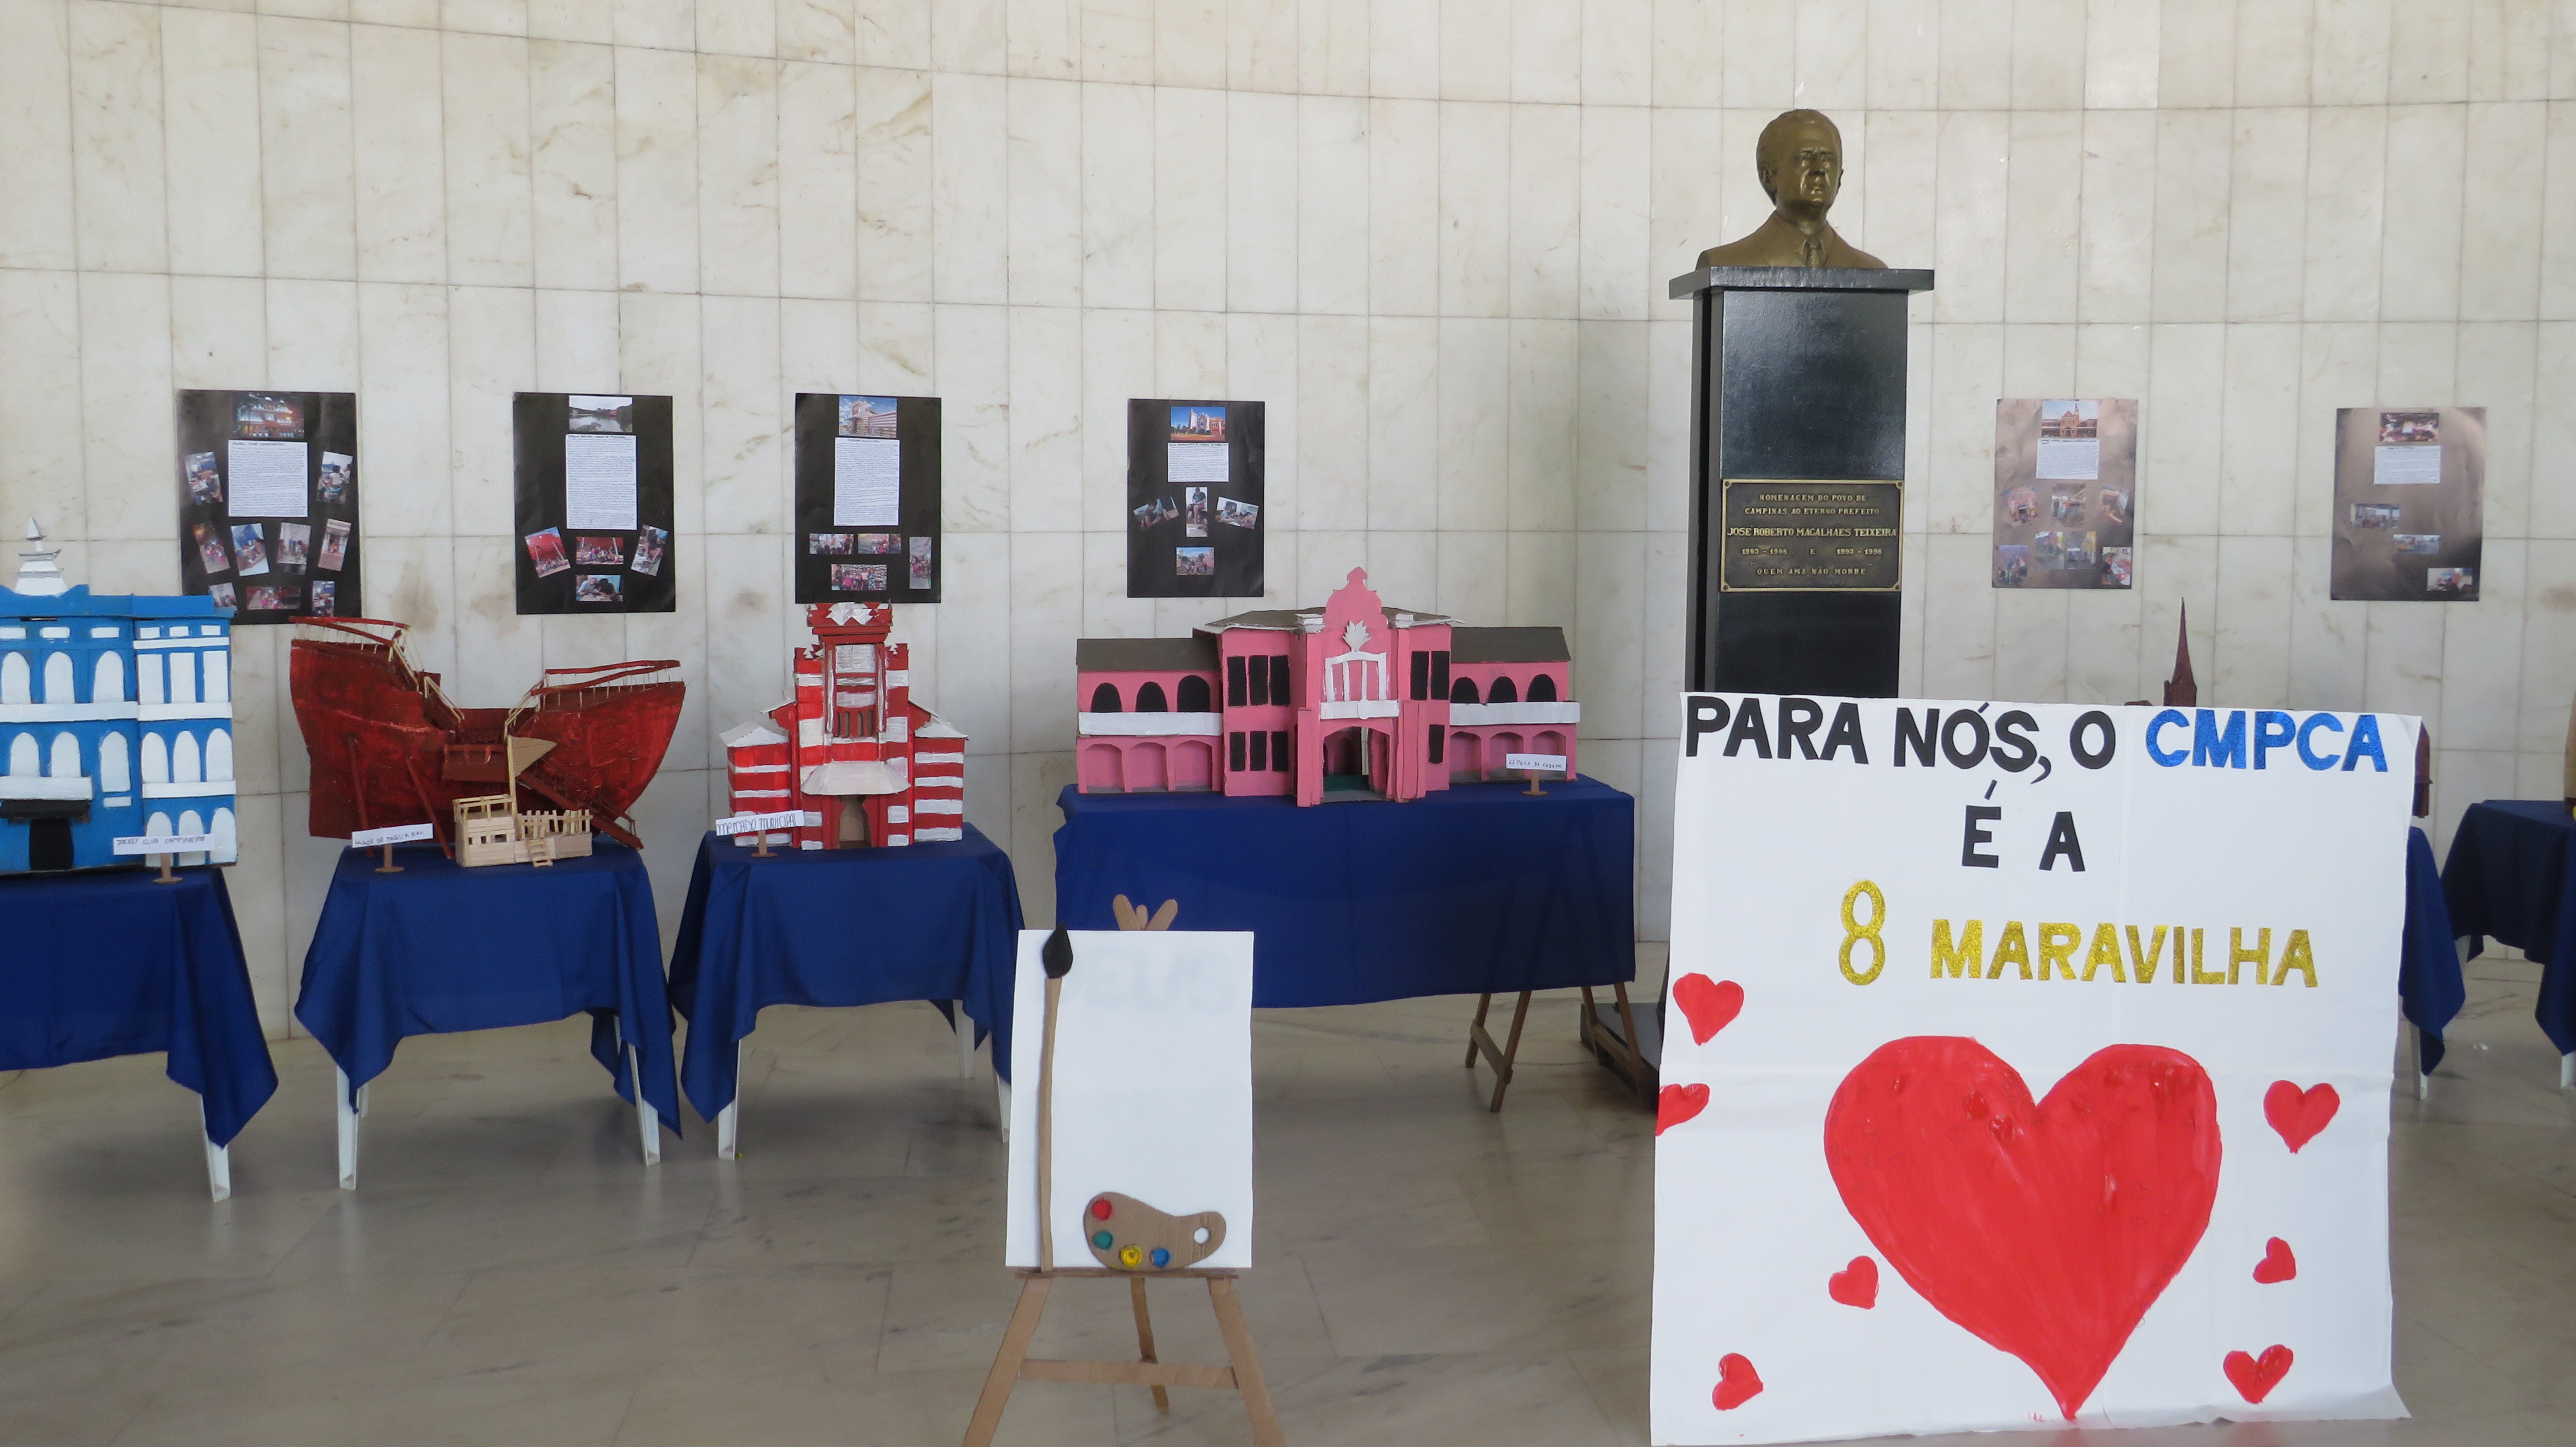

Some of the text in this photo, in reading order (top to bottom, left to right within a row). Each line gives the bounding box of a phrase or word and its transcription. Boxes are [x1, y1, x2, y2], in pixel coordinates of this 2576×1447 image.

[1753, 528, 1794, 537] ROBERTO
[1853, 528, 1897, 537] TEIXEIRA
[1687, 696, 2388, 784] PARA NÓS, O CMPCA
[1962, 780, 2086, 872] É A
[1840, 880, 2318, 987] 8 MARAVILHA
